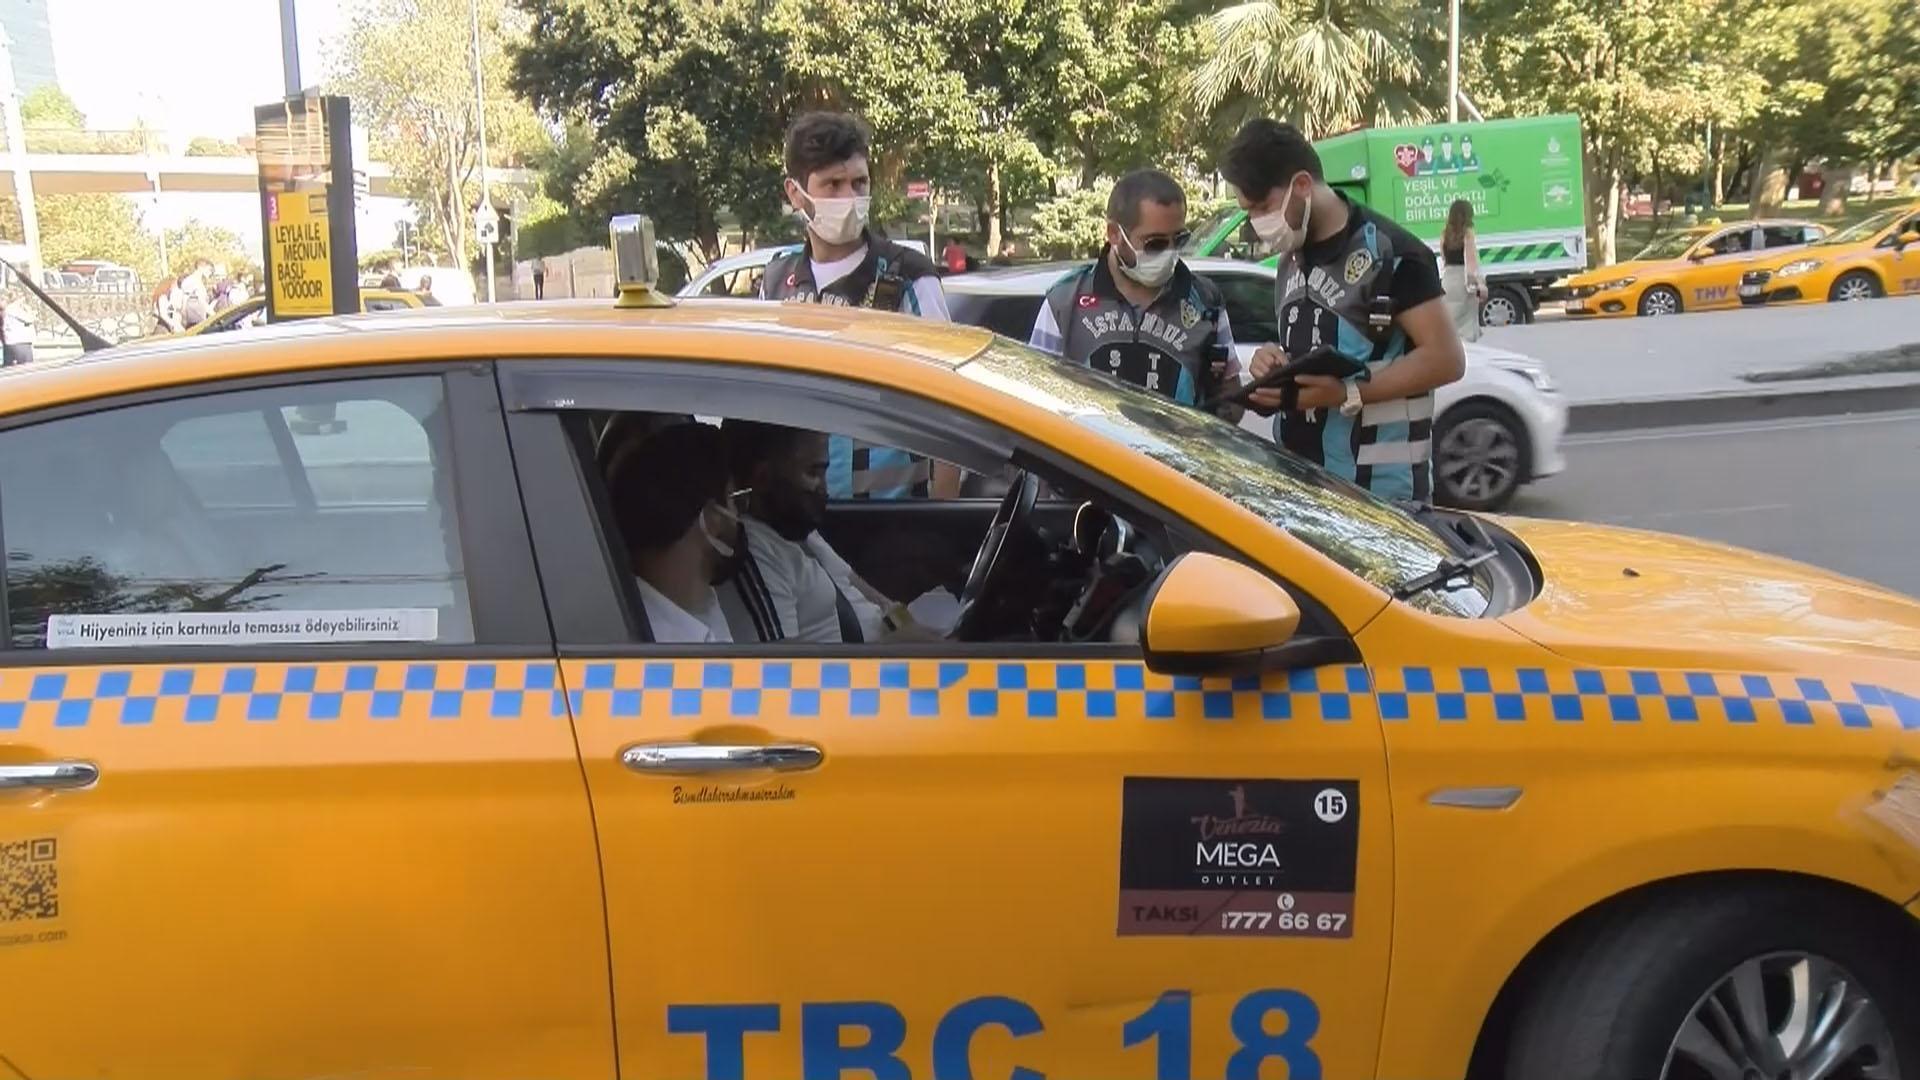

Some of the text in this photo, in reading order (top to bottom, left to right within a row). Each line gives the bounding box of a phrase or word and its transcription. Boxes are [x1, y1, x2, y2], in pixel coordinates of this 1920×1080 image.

[1404, 176, 1458, 193] YEŞİL VE
[1405, 192, 1441, 208] DOĞA
[1406, 208, 1426, 221] BİR
[275, 224, 303, 243] LEYLA
[283, 241, 327, 261] MECNUN
[281, 280, 323, 300] YOOOOR
[1694, 285, 1728, 300] THV
[80, 615, 399, 641] Hijyeniniz için kartınızla temassız ödeyebilirsiniz
[1318, 796, 1344, 815] 15
[1191, 815, 1283, 840] Venezia
[1196, 842, 1280, 867] MEGA
[1201, 875, 1275, 886] OUTLET
[1278, 912, 1309, 930] 66
[1316, 912, 1347, 931] 67
[667, 988, 1323, 1080] TBC 18
